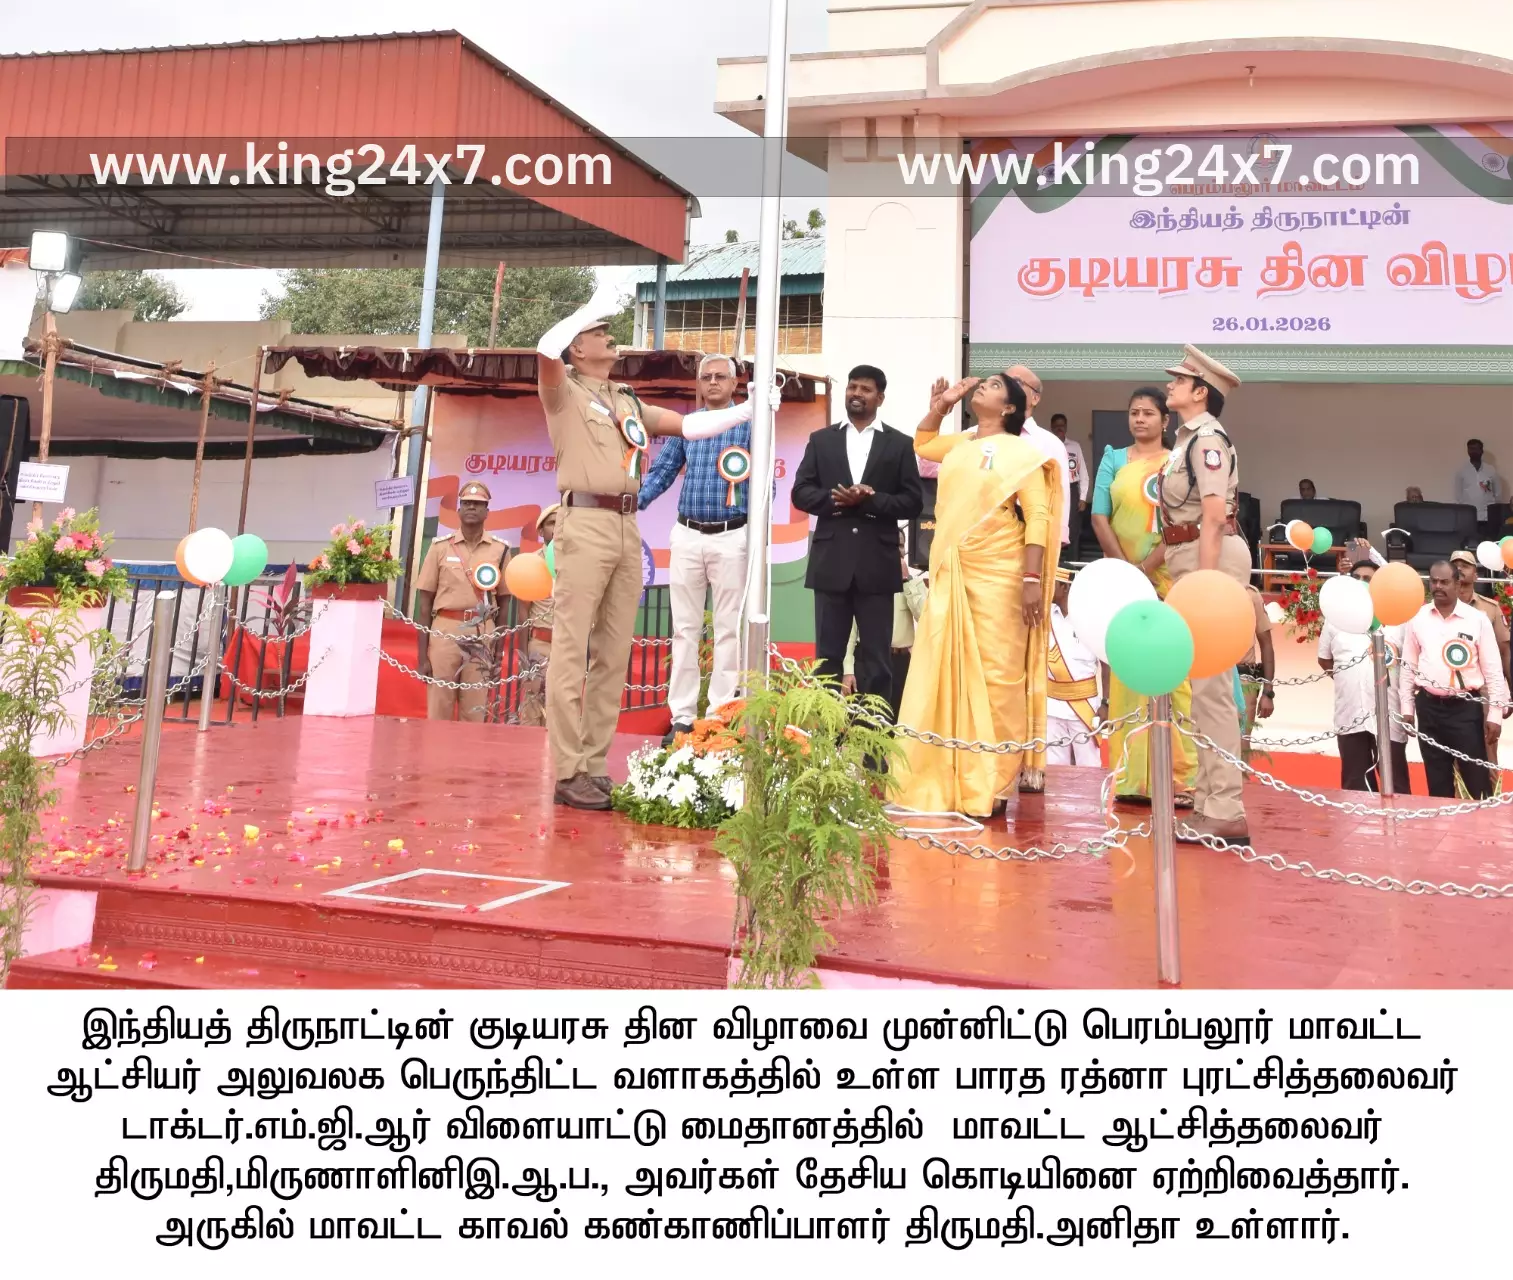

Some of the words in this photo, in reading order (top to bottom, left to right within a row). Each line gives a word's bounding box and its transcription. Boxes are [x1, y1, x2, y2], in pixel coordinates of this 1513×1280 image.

[1129, 205, 1244, 234] இந்தியத்
[1250, 202, 1411, 232] திருநாட்டின்
[1017, 255, 1243, 298] குடியரசு
[1256, 240, 1369, 299] தின
[1386, 240, 1513, 300] விழ
[1212, 317, 1331, 332] 26.01.2026
